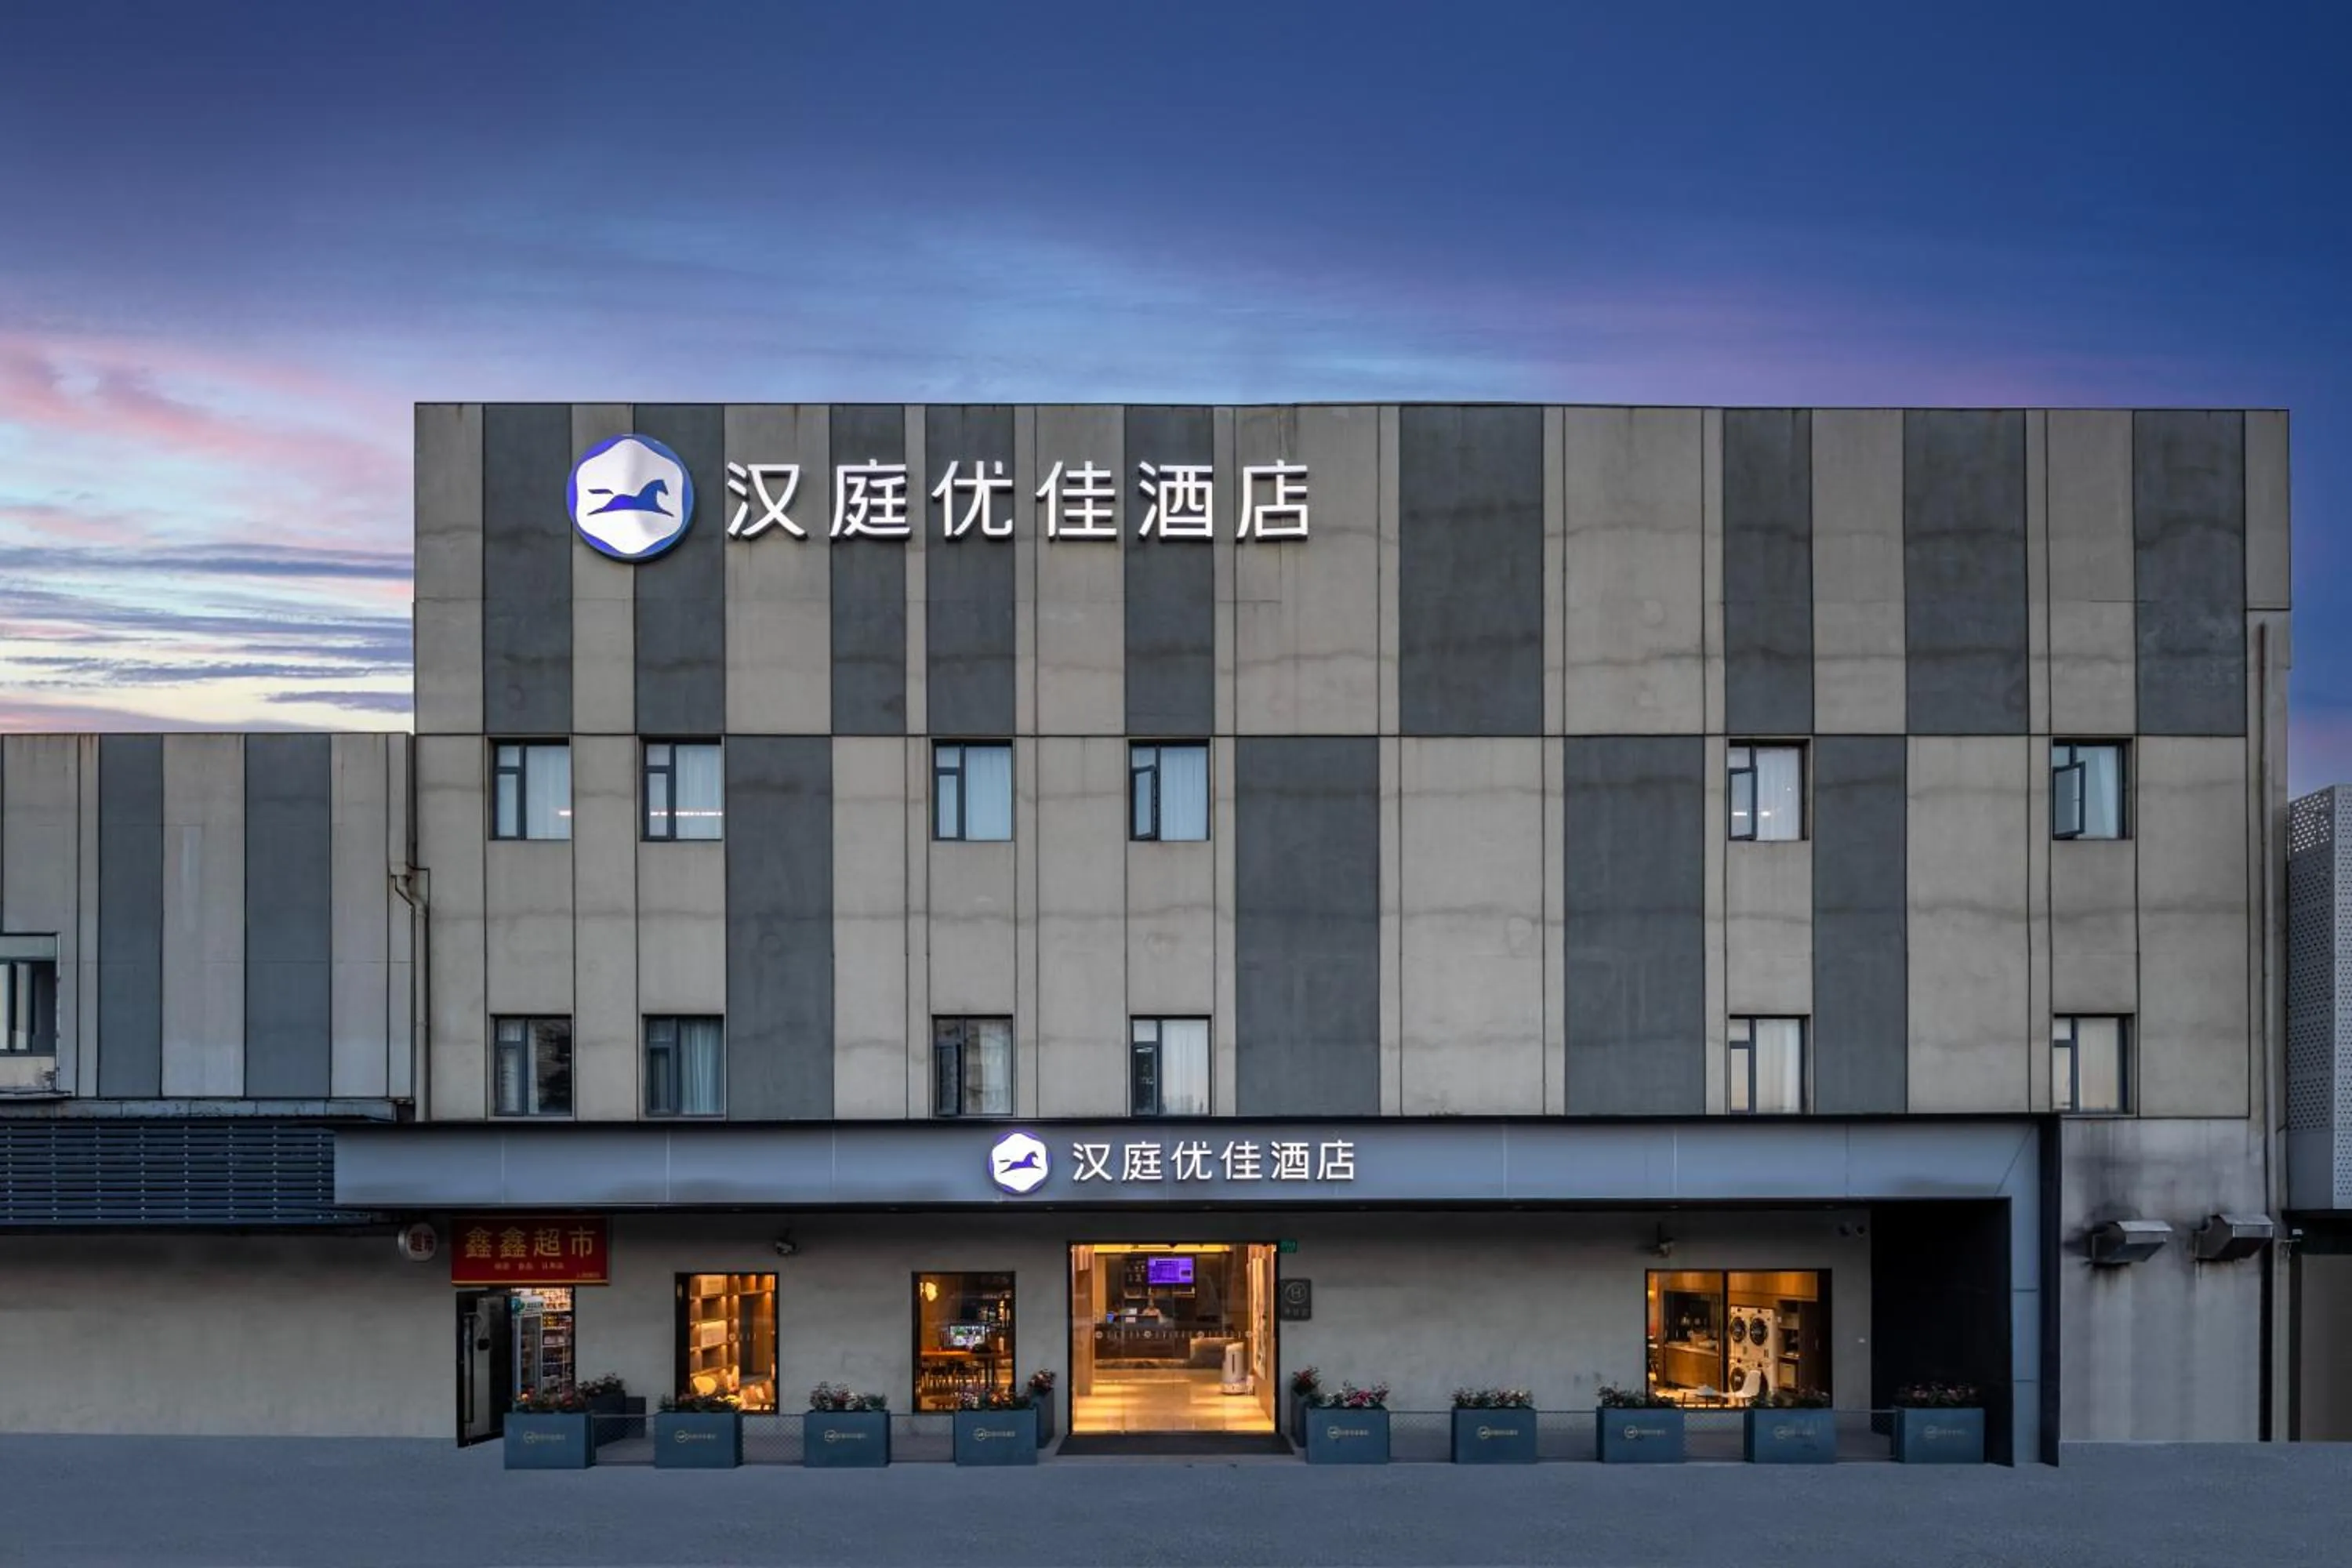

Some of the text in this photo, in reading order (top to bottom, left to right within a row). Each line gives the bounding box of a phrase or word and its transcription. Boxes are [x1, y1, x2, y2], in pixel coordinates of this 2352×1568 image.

[726, 459, 1310, 539] 汉庭优佳酒店
[1072, 1140, 1355, 1181] 汉庭优佳酒店
[465, 1226, 597, 1258] 鑫鑫超市
